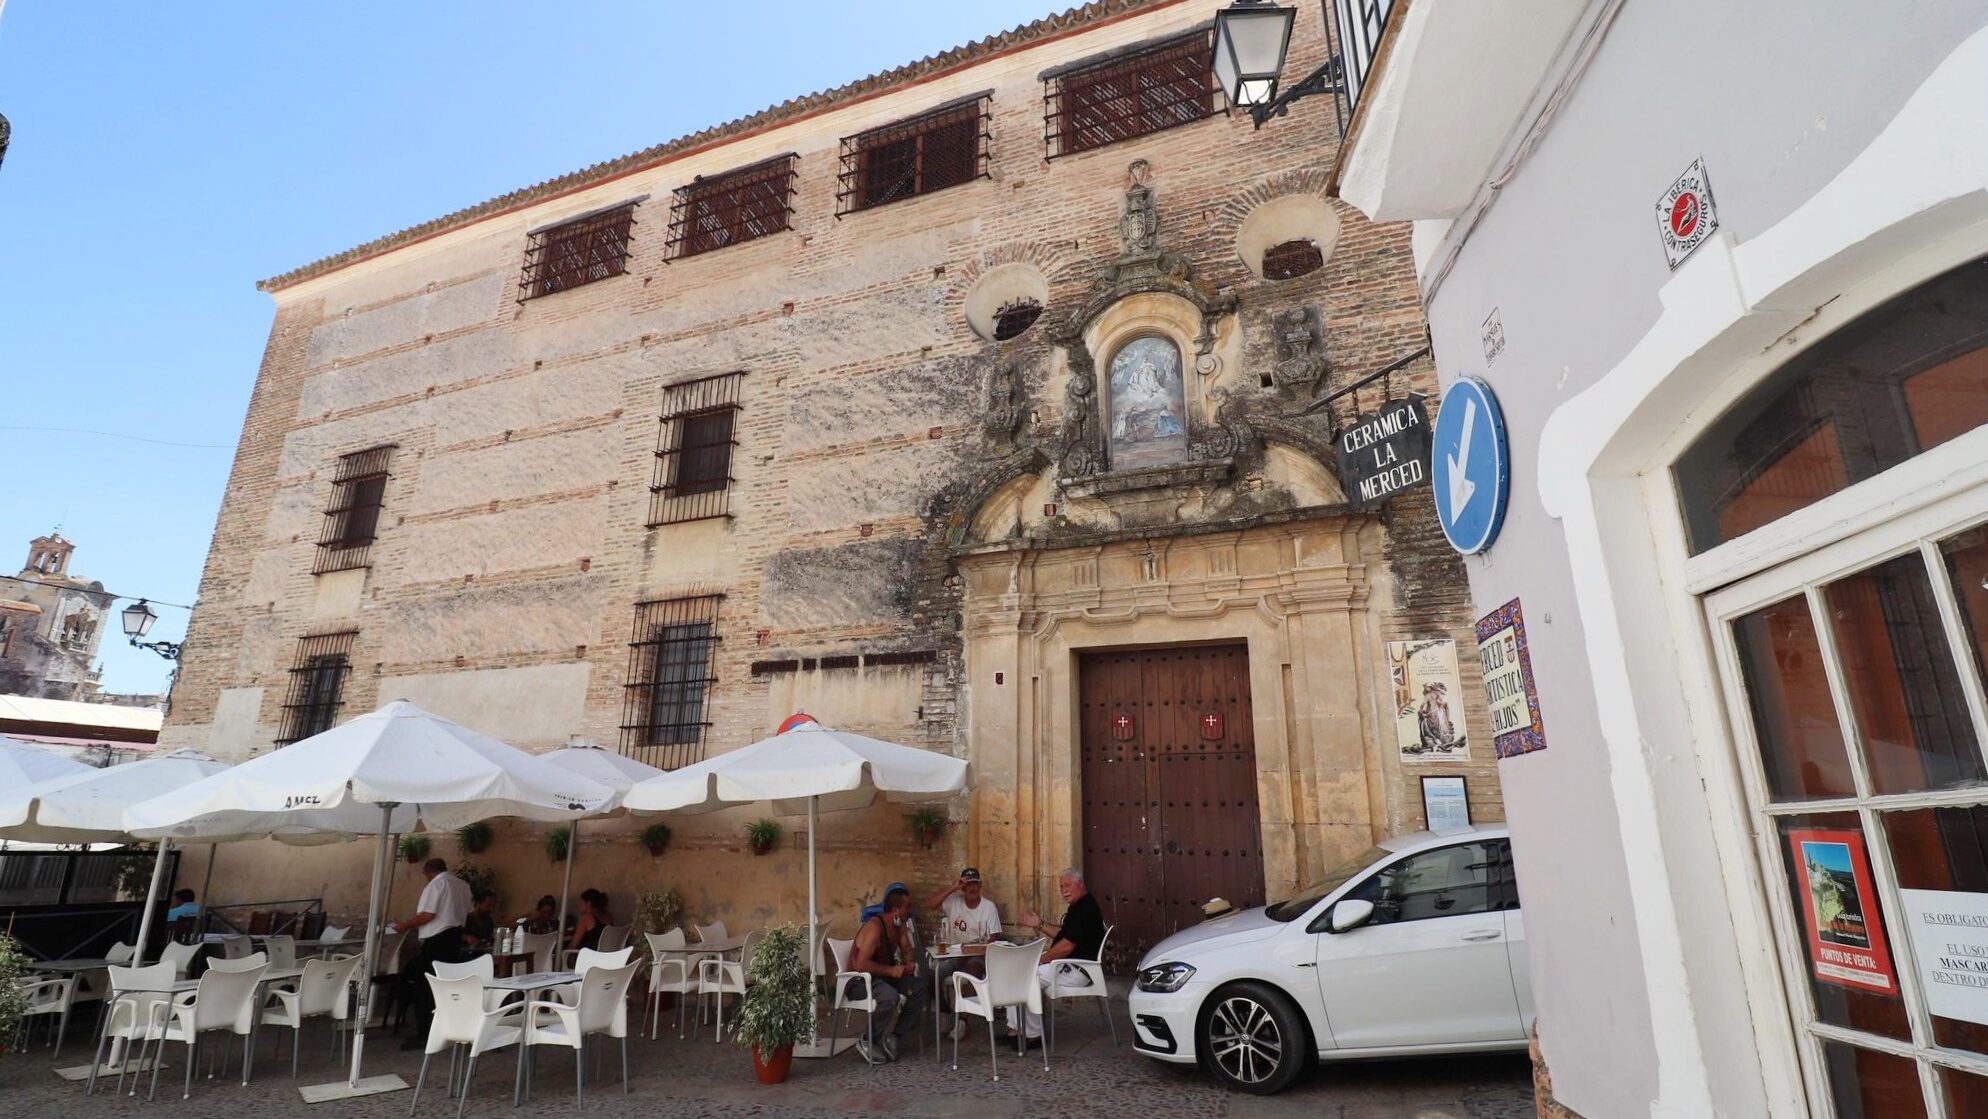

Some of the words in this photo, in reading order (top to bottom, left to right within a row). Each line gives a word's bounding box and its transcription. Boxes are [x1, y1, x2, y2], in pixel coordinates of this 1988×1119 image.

[1663, 207, 1671, 222] LA
[1344, 405, 1419, 453] CERAMICA
[1373, 443, 1397, 468] LA
[1360, 459, 1423, 501] MERCED
[1922, 912, 1936, 923] ES
[1821, 947, 1843, 963] PUNTOS
[1843, 952, 1853, 965] DE
[1947, 943, 1961, 955] EL
[1963, 944, 1984, 956] USO
[1940, 957, 1988, 972] MASCAR
[1932, 970, 1976, 985] DENTRO
[1979, 976, 1988, 987] D
